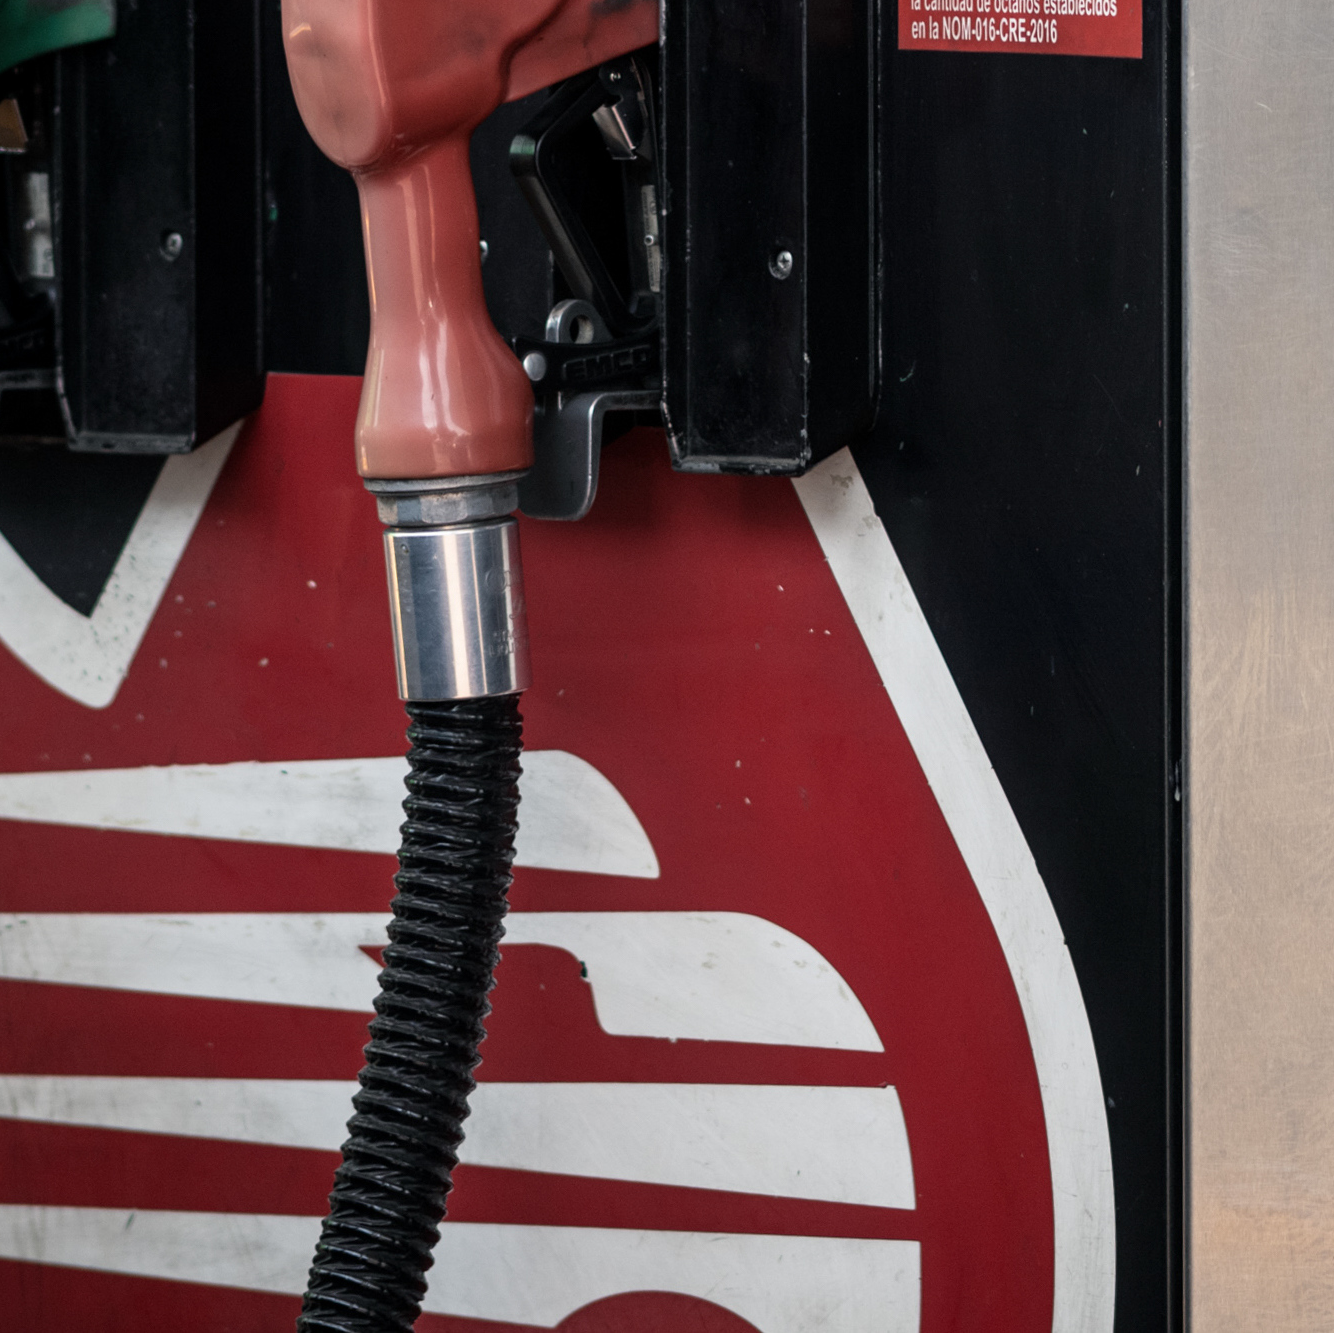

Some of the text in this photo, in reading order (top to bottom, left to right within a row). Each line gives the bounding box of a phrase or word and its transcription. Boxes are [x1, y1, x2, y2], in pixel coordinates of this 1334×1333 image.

[911, 16, 1058, 44] en la NOM-016-CRE-2016
